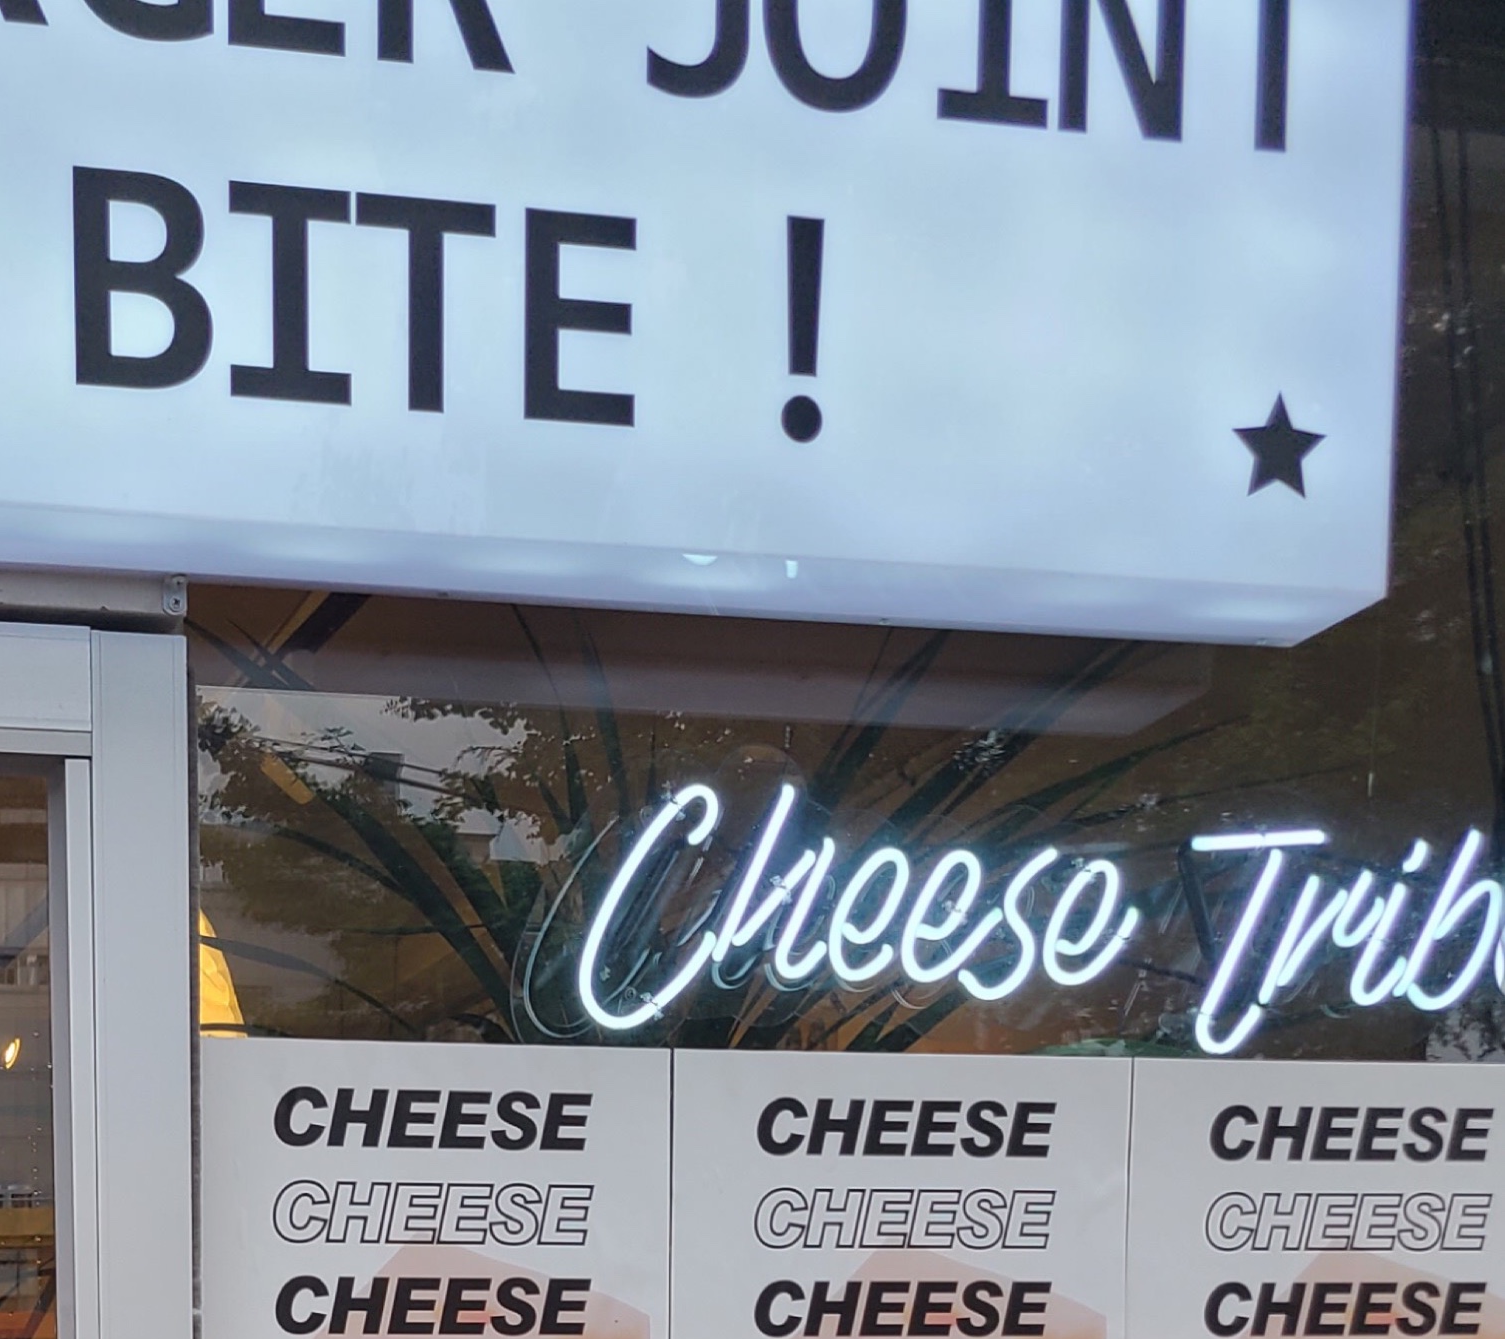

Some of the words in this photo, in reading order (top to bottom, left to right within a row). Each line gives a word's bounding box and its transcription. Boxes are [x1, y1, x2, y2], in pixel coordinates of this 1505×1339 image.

[71, 165, 637, 428] BITE
[780, 215, 826, 444] !
[579, 783, 1139, 1031] Cheese
[1191, 825, 1505, 1054] Trib
[273, 1085, 593, 1151] CHEESE
[756, 1096, 1057, 1158] CHEESE
[1209, 1104, 1495, 1162] CHEESE
[272, 1179, 594, 1246] CHEESE
[753, 1186, 1056, 1250] CHEESE
[1203, 1190, 1492, 1252] CHEESE
[274, 1275, 591, 1336] CHEESE
[753, 1279, 1052, 1338] CHEESE
[1203, 1280, 1487, 1336] CHEESE
